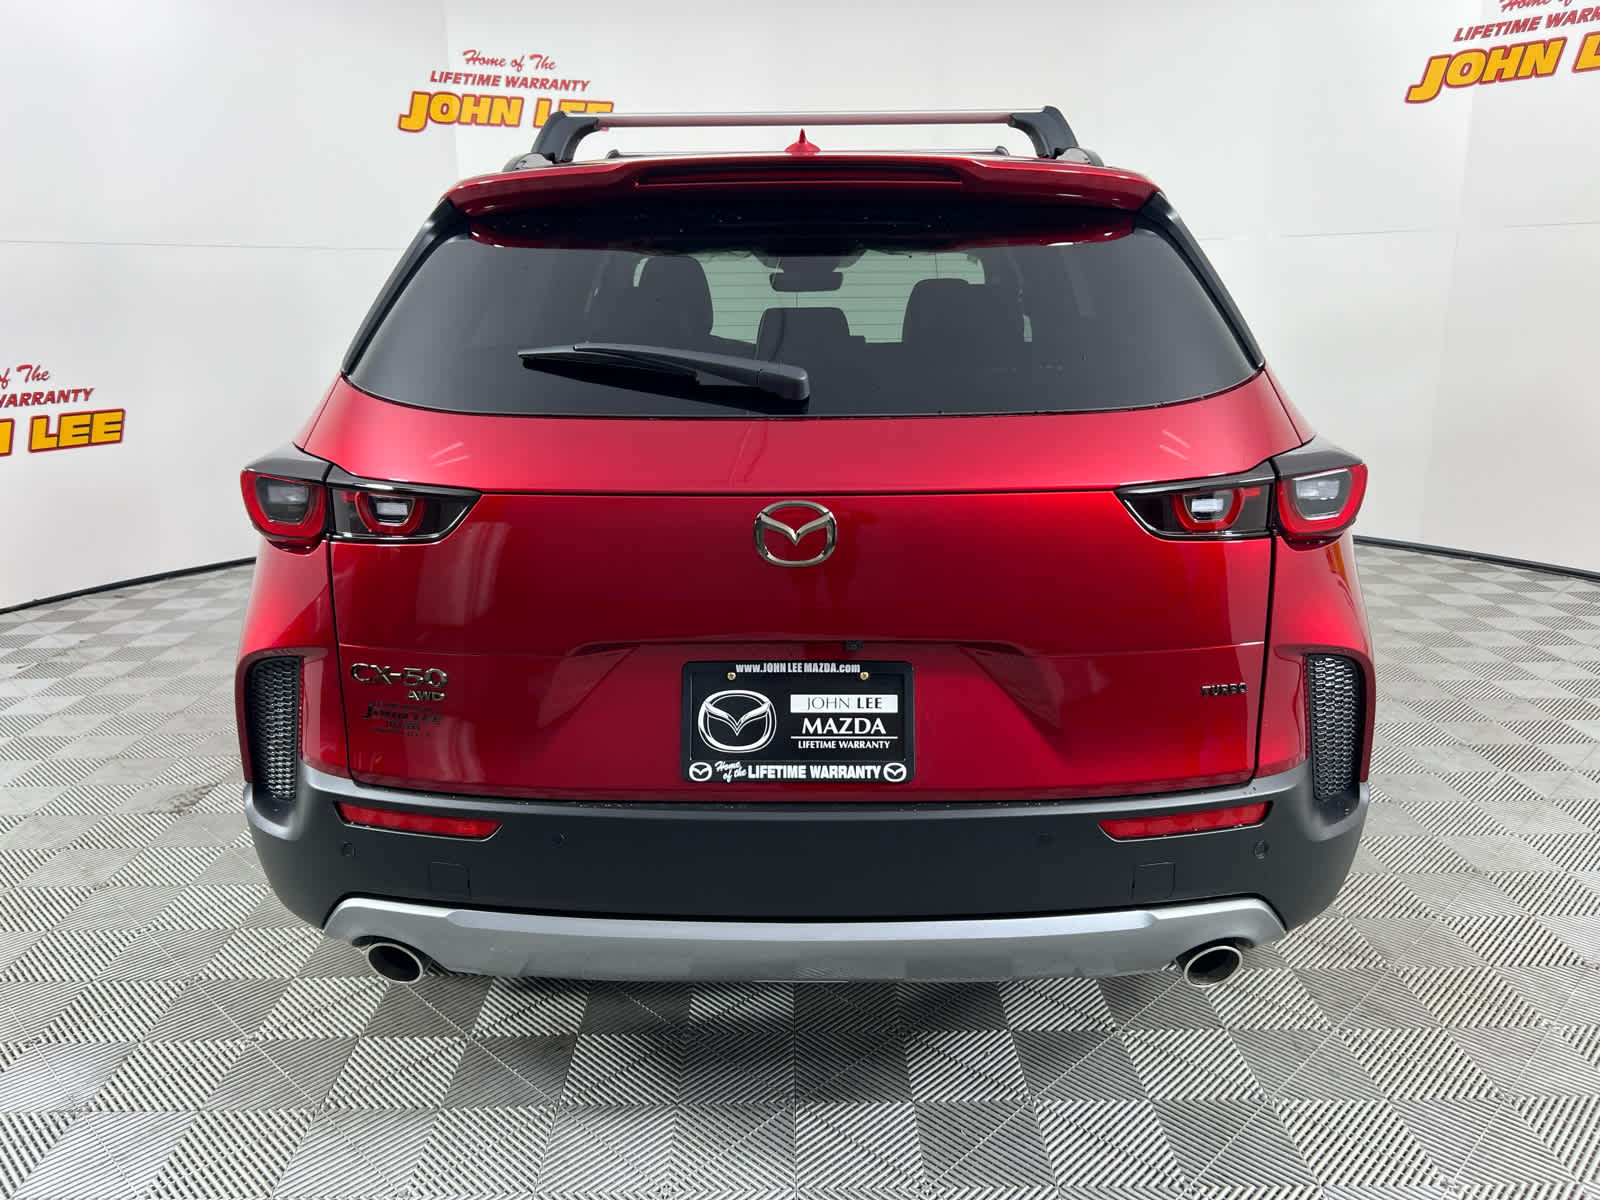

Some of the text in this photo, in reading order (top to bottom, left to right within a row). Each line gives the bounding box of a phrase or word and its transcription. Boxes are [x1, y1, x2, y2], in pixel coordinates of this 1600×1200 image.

[1453, 16, 1542, 42] LIFETIME
[462, 49, 556, 72] Home of The
[1404, 37, 1567, 104] JOHN
[429, 70, 591, 92] LIFETIME WARRANTY
[397, 91, 525, 133] JOHN
[16, 364, 50, 383] The
[27, 407, 126, 454] LEE
[350, 662, 448, 688] CX-50
[735, 662, 861, 673] www.JOHN LEE MAZDA.com
[408, 690, 446, 702] AWD
[1201, 682, 1247, 697] TURBO
[807, 697, 883, 711] JOHN LEE
[801, 717, 887, 735] MAZDA
[797, 740, 891, 749] LIFETIME WARRANTY
[714, 760, 743, 773] Home
[722, 767, 748, 784] of the
[747, 764, 882, 780] LIFETIME WARRANTY
